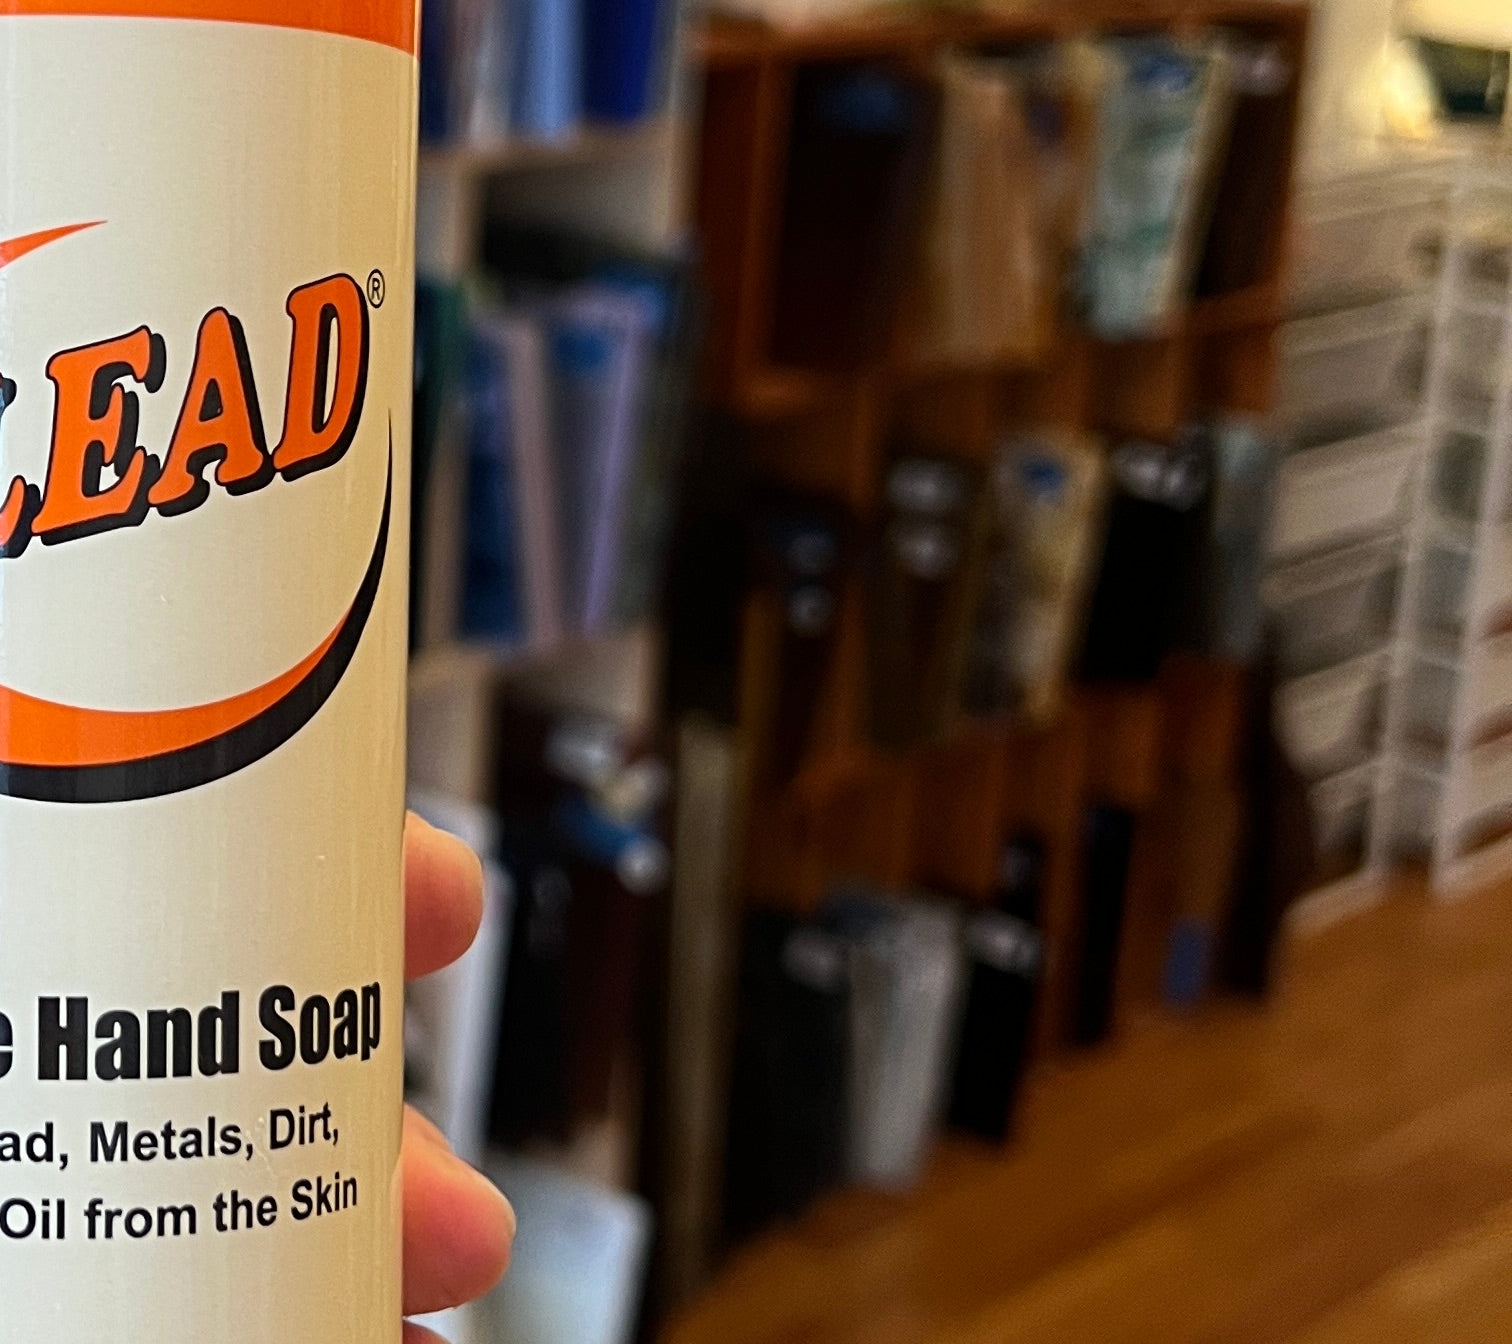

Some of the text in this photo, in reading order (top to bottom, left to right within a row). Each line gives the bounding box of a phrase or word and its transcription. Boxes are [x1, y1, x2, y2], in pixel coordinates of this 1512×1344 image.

[37, 990, 240, 1081] Hand
[258, 980, 381, 1071] Soap
[90, 1116, 254, 1163] Metals,
[269, 1102, 340, 1151] Dirt,
[84, 1199, 198, 1240] from
[213, 1190, 278, 1234] the
[291, 1172, 358, 1222] Skin
